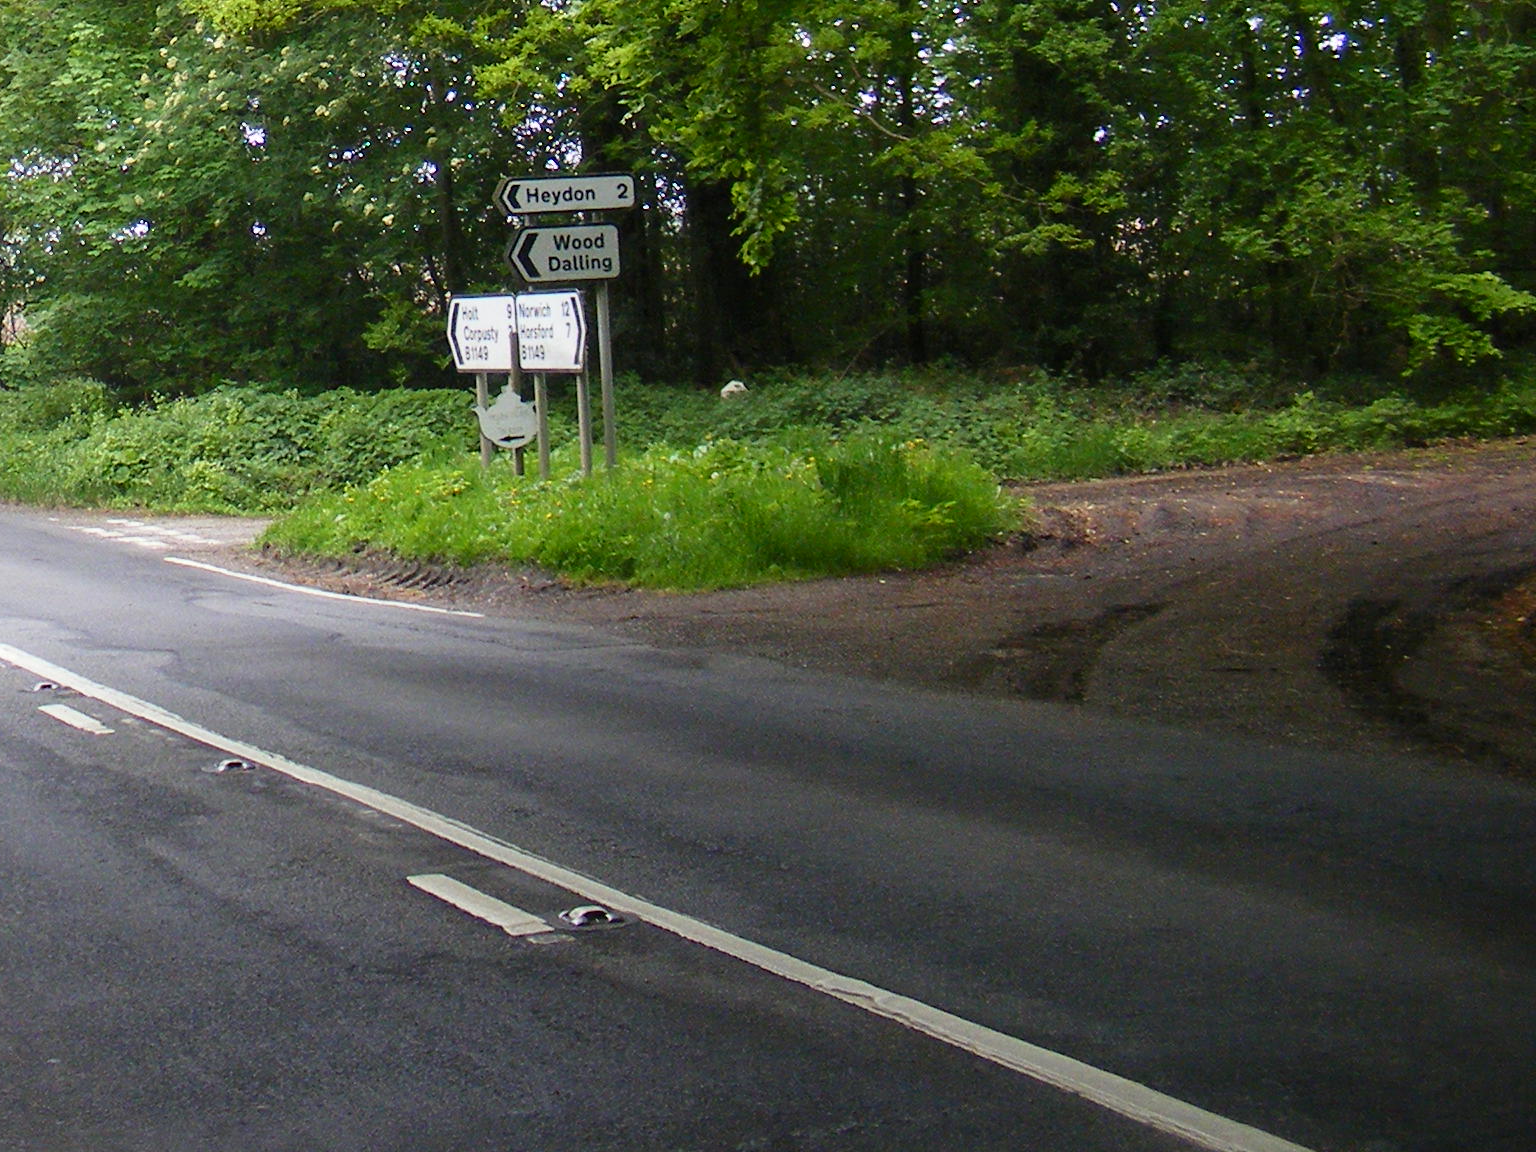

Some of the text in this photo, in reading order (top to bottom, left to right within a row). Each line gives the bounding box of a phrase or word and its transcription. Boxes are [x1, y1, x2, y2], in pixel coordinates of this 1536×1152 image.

[526, 183, 628, 205] Heydon 2
[553, 234, 605, 251] Wood
[548, 255, 613, 272] Dalling
[519, 301, 570, 318] Norwich 12
[464, 326, 498, 343] Corpusty
[520, 322, 571, 338] Horsford 7
[465, 346, 488, 360] B1149
[522, 345, 545, 360] B1149
